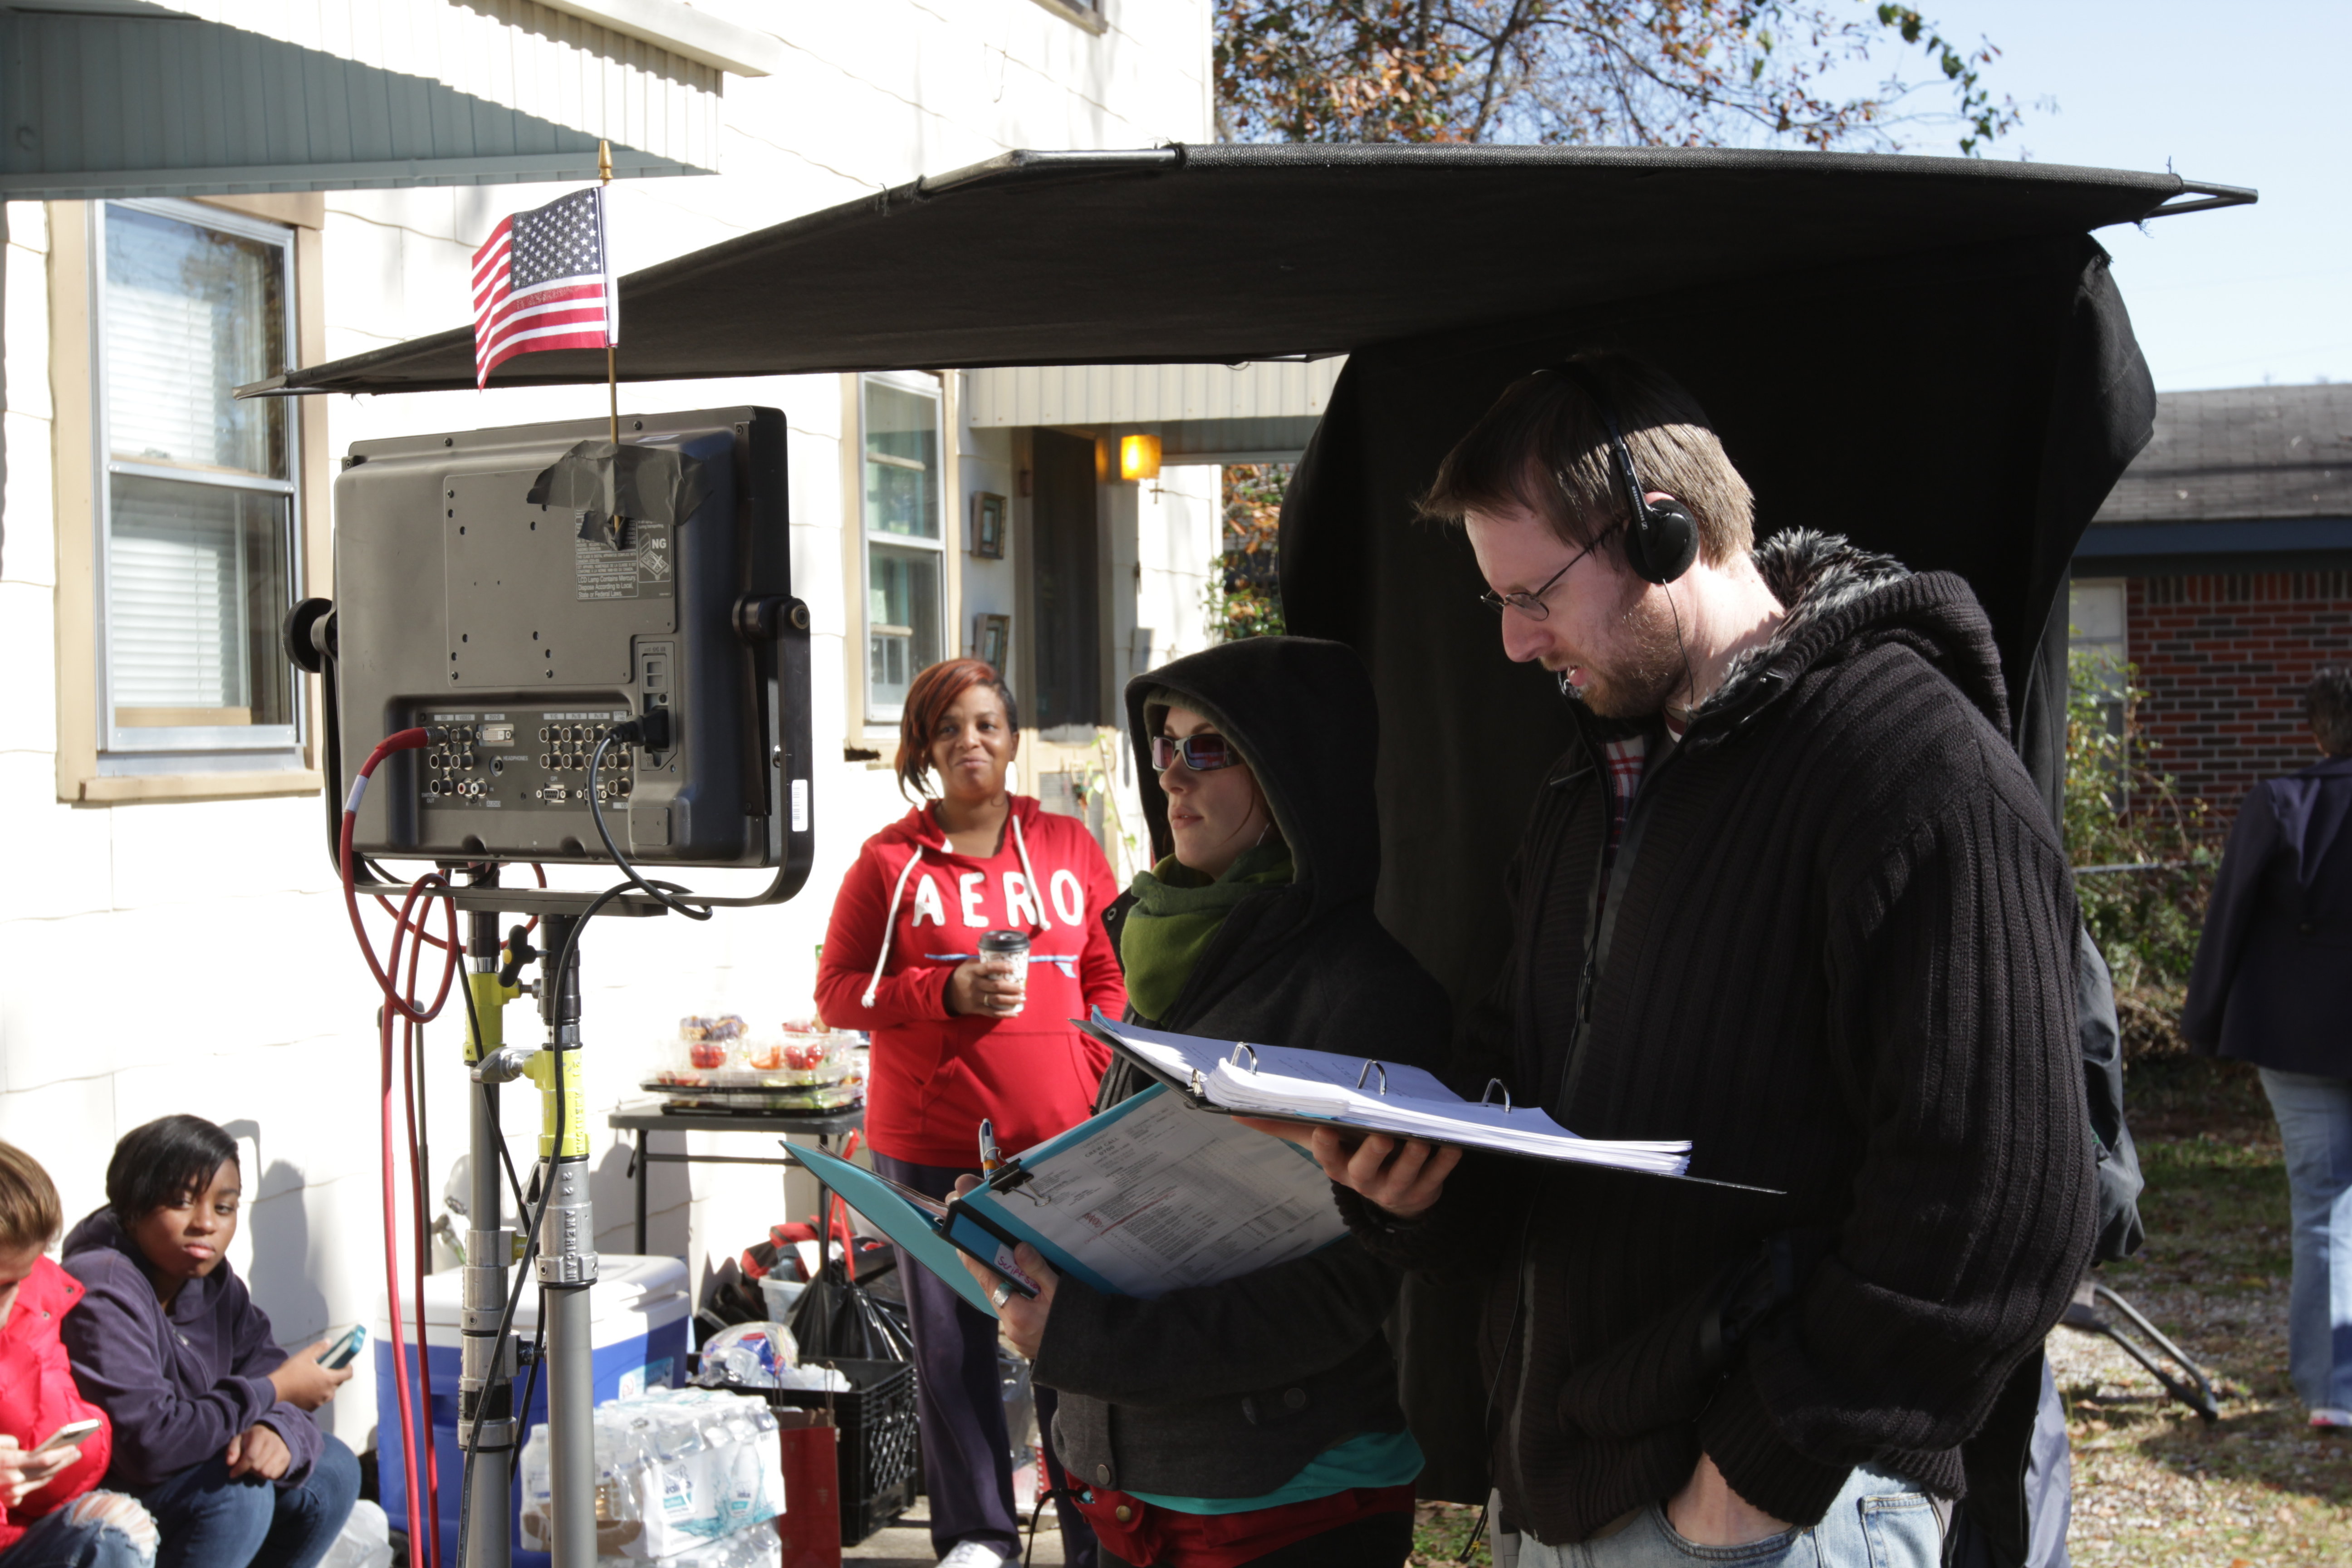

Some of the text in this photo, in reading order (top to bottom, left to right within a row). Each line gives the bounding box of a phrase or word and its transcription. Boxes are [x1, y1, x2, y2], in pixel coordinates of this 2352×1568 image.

[652, 538, 666, 549] NG
[911, 869, 1085, 928] AERO
[1085, 1146, 1103, 1157] CREW
[1104, 1137, 1119, 1147] CALL
[1098, 1145, 1115, 1156] 0700
[563, 1171, 574, 1196] 22
[566, 1210, 577, 1279] AMERICAN
[998, 1256, 1024, 1278] Script
